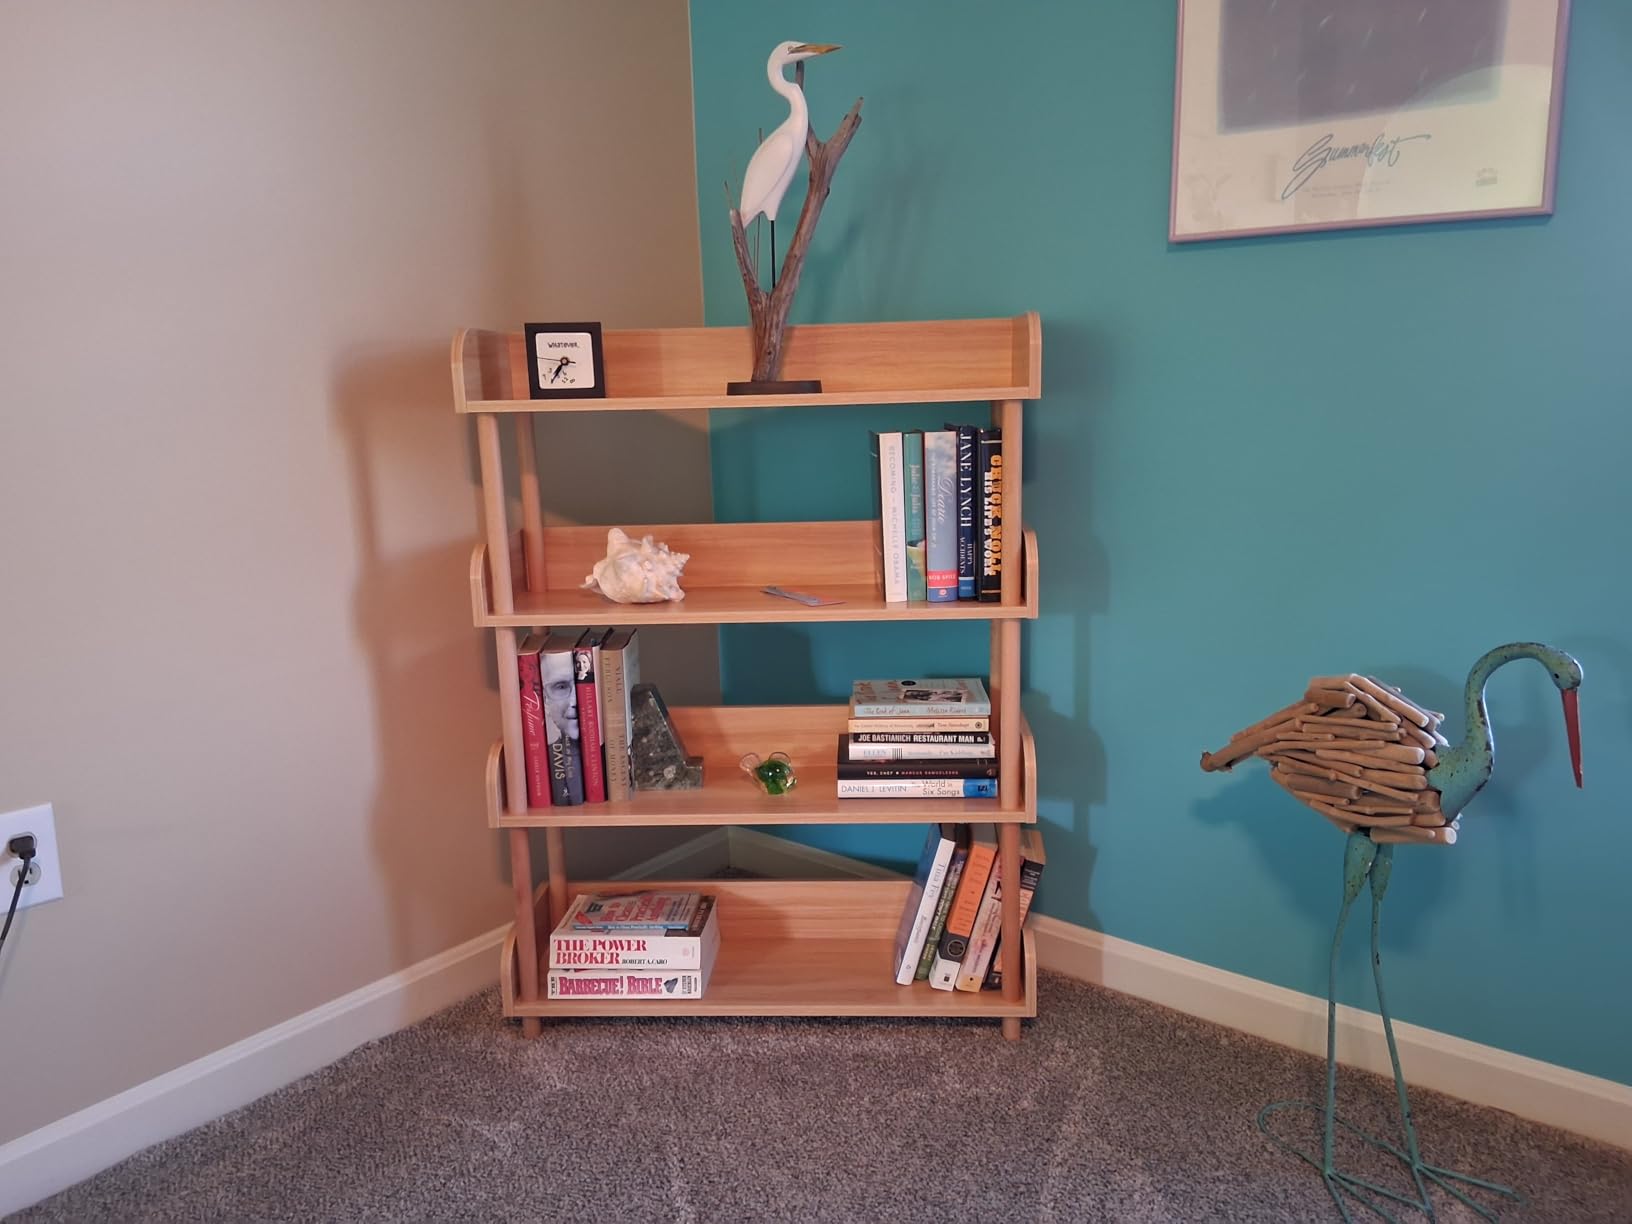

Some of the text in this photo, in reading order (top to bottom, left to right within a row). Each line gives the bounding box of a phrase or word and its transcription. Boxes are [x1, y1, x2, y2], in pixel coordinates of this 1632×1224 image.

[1282, 133, 1431, 200] Summerfest
[910, 464, 920, 486] Julie
[960, 434, 972, 527] JANE LYNCH
[984, 472, 992, 493] HIS
[911, 493, 920, 514] Julia
[936, 475, 954, 526] Dearie
[991, 454, 1002, 576] CHUCK NOLL
[984, 539, 992, 576] WORK
[605, 657, 613, 703] FERGUSON
[523, 690, 540, 736] Perfume
[588, 721, 596, 752] RODHAM
[553, 743, 565, 780] DAVIS
[591, 754, 599, 786] CLINTON
[879, 784, 907, 792] LEVITIN
[937, 788, 959, 797] Songs
[933, 864, 945, 882] Tina
[931, 915, 939, 930] WALK
[554, 940, 647, 951] THE POWER
[554, 952, 620, 964] BROKER
[559, 976, 623, 995] BARBECUE!
[627, 976, 663, 995] BIBLE
